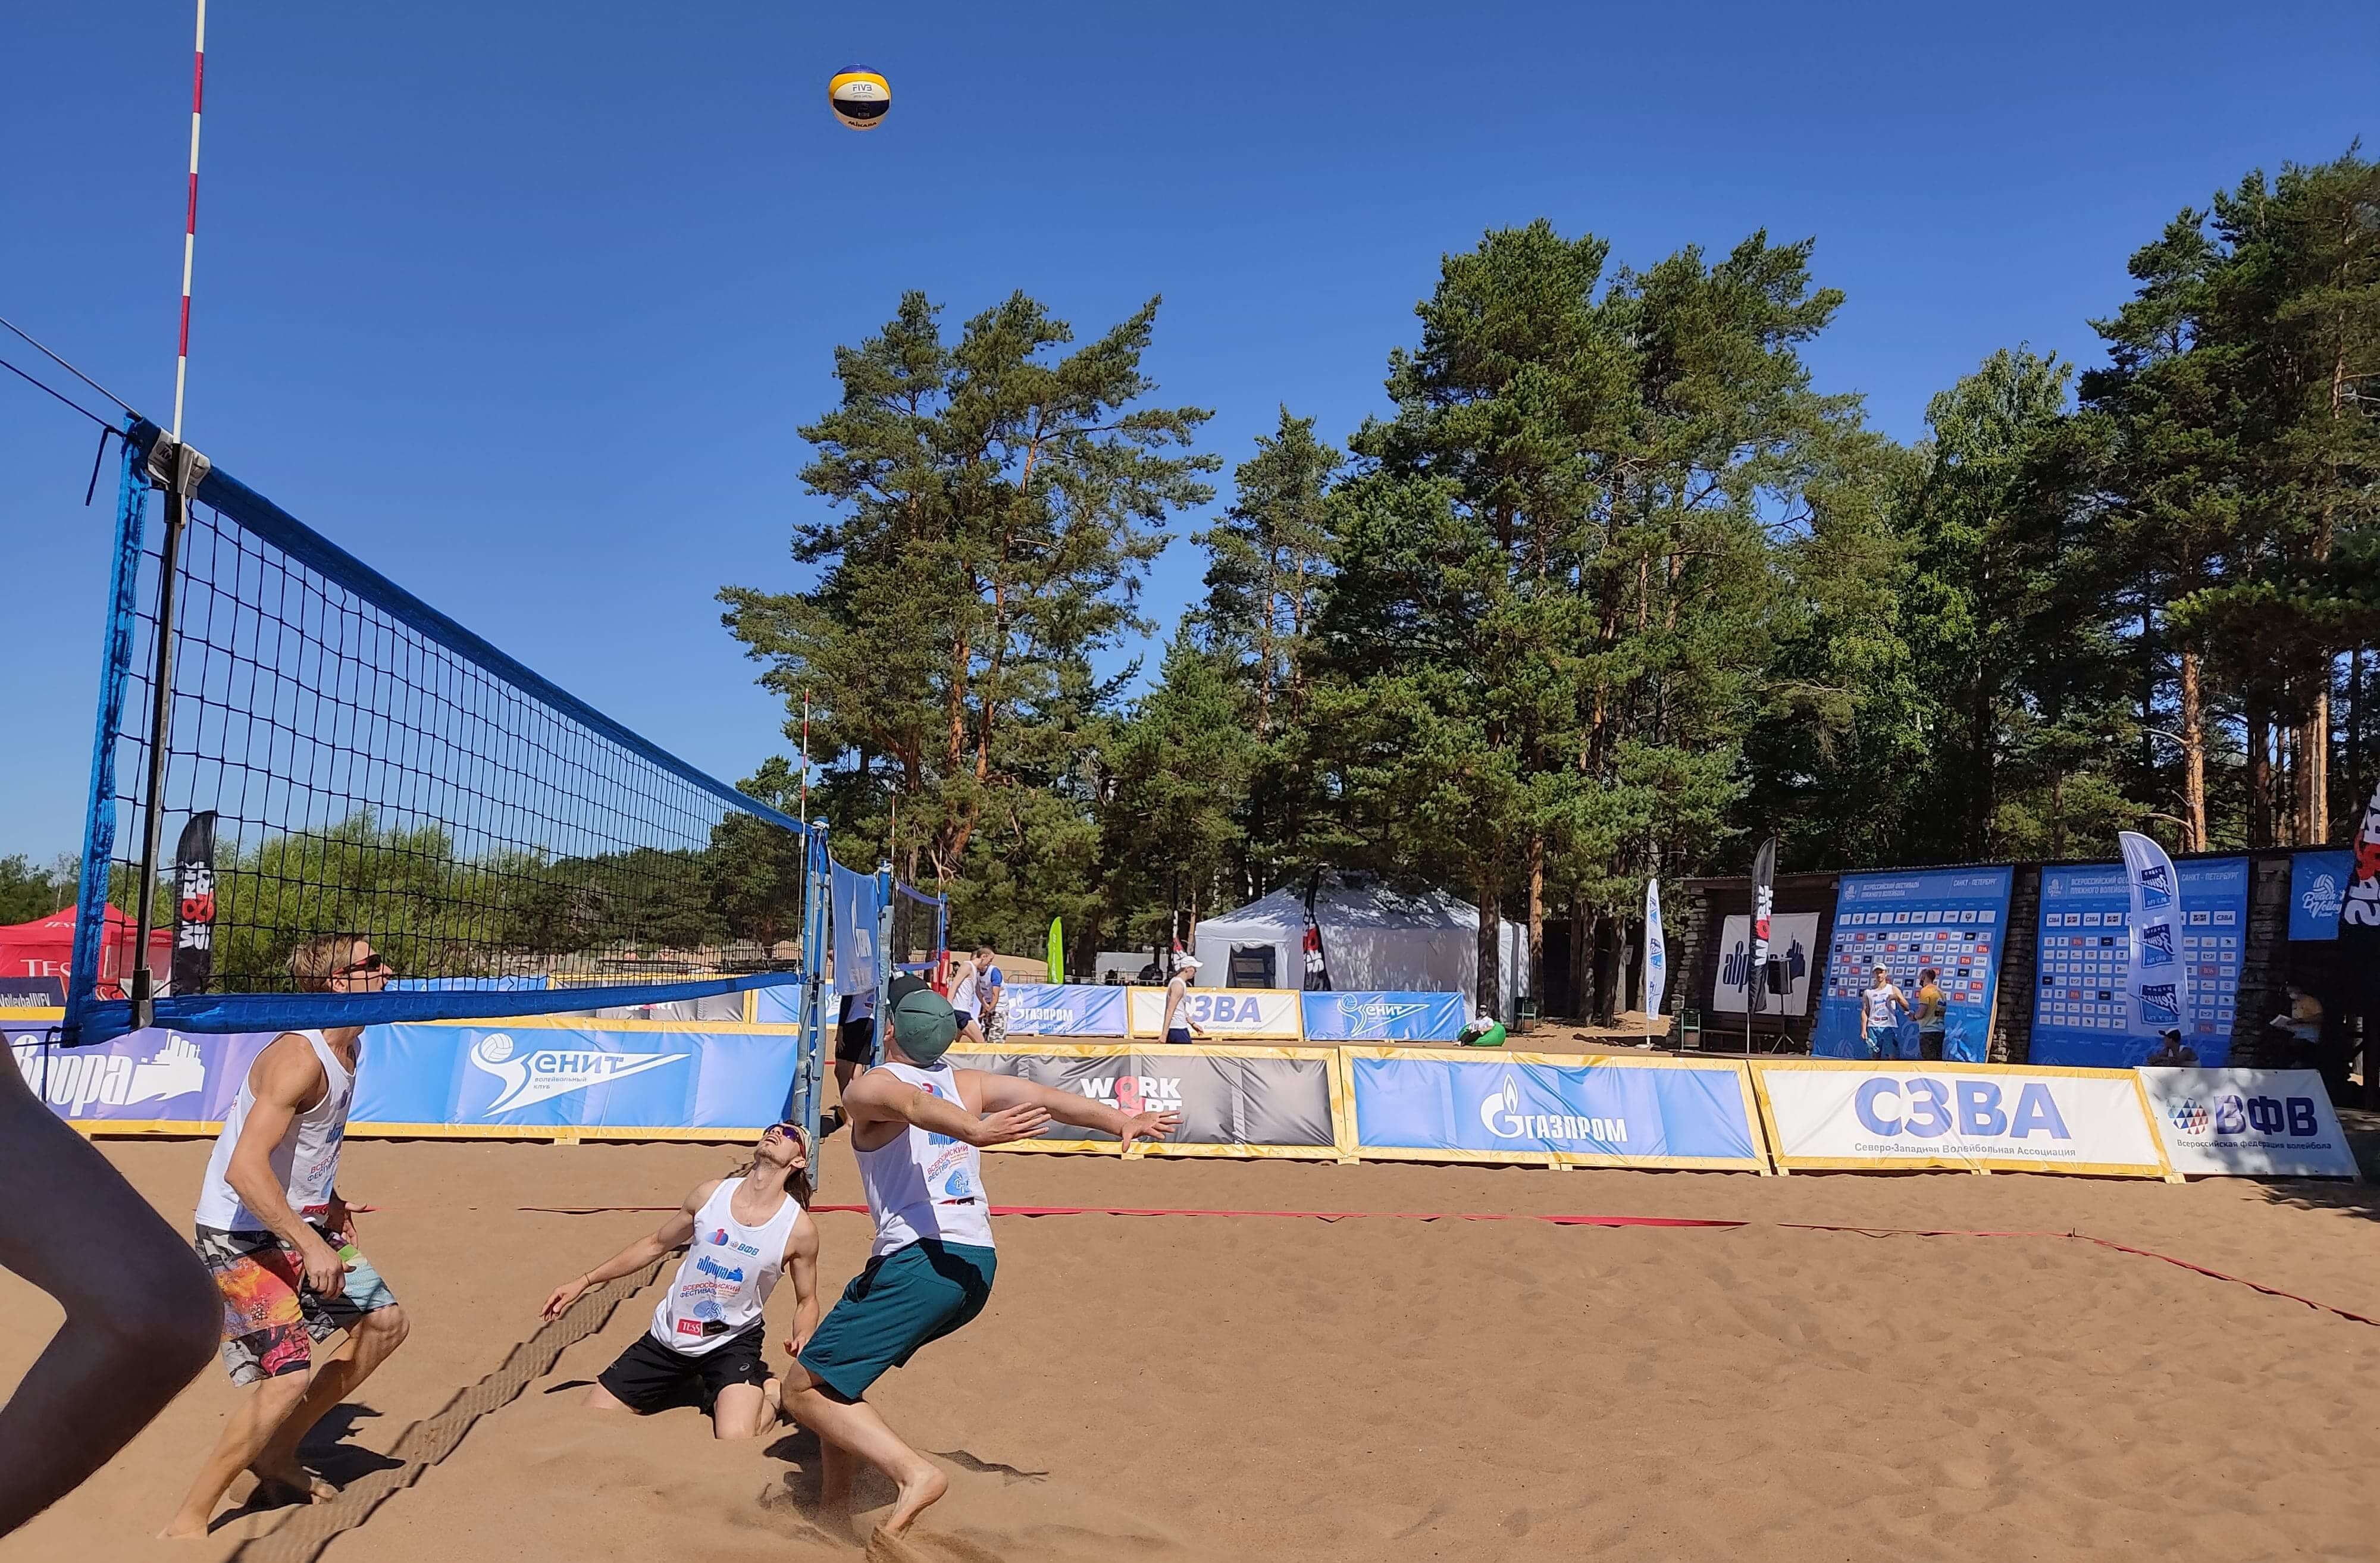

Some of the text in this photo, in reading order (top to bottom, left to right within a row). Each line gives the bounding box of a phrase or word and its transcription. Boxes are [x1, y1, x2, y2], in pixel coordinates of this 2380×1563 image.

[20, 959, 71, 977] TES
[1025, 1008, 1073, 1022] ГАЗПРОМ
[1186, 995, 1261, 1022] ЗВА
[1855, 1077, 2072, 1139] СЗВА
[2214, 1095, 2318, 1137] ВФВ
[1524, 1114, 1628, 1142] ГАЗПРОМ
[1855, 1143, 2076, 1157] Северо-Западная Волейбольная Ассоциация
[2177, 1139, 2332, 1149] Всероссийская федерация волейбола
